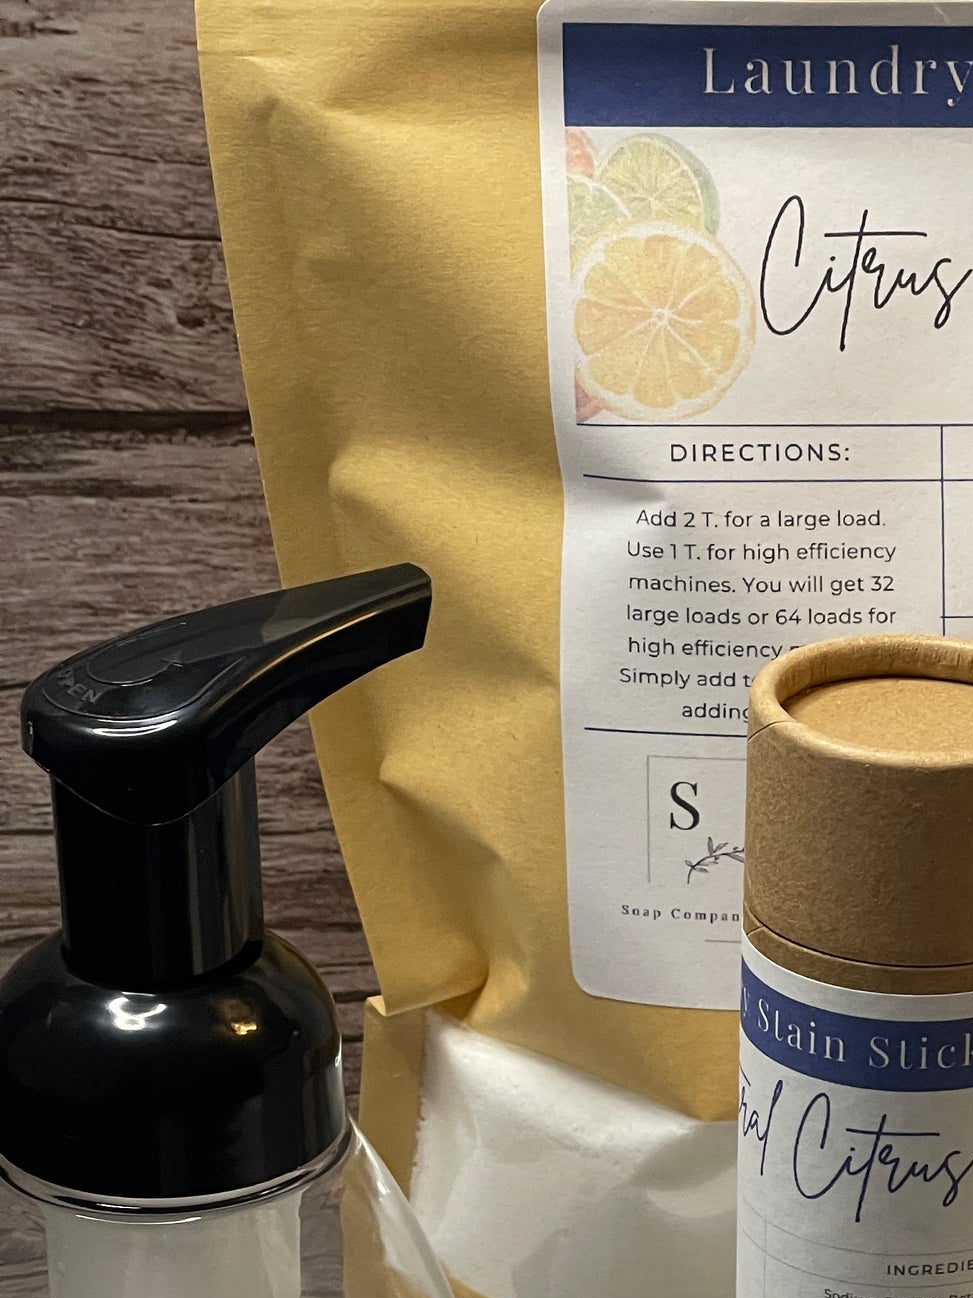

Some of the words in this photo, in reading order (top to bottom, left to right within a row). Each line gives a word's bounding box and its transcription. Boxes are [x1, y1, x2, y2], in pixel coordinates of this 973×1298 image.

[705, 45, 973, 106] Laundry
[760, 195, 973, 352] Citrus
[671, 444, 849, 462] DIRECTIONS:
[636, 510, 676, 527] Add
[684, 512, 695, 527] 2
[702, 512, 717, 527] T.
[724, 511, 752, 527] for
[761, 515, 770, 527] a
[778, 511, 830, 530] large
[838, 510, 886, 526] load.
[628, 541, 663, 558] Use
[670, 544, 676, 559] 1
[684, 544, 700, 560] T.
[707, 544, 735, 560] for
[744, 544, 789, 564] high
[797, 543, 896, 562] efficiency
[630, 575, 735, 592] machines.
[742, 578, 781, 593] You
[789, 576, 822, 592] will
[831, 578, 864, 596] get
[871, 576, 894, 591] 32
[627, 605, 678, 626] large
[687, 608, 741, 624] loads
[748, 613, 769, 625] or
[776, 609, 801, 625] 64
[809, 608, 862, 624] loads
[868, 608, 896, 623] for
[629, 637, 674, 657] high
[682, 640, 782, 661] efficiency
[620, 668, 690, 689] Simply
[697, 672, 735, 687] add
[670, 782, 699, 830] S
[758, 999, 844, 1061] Stain
